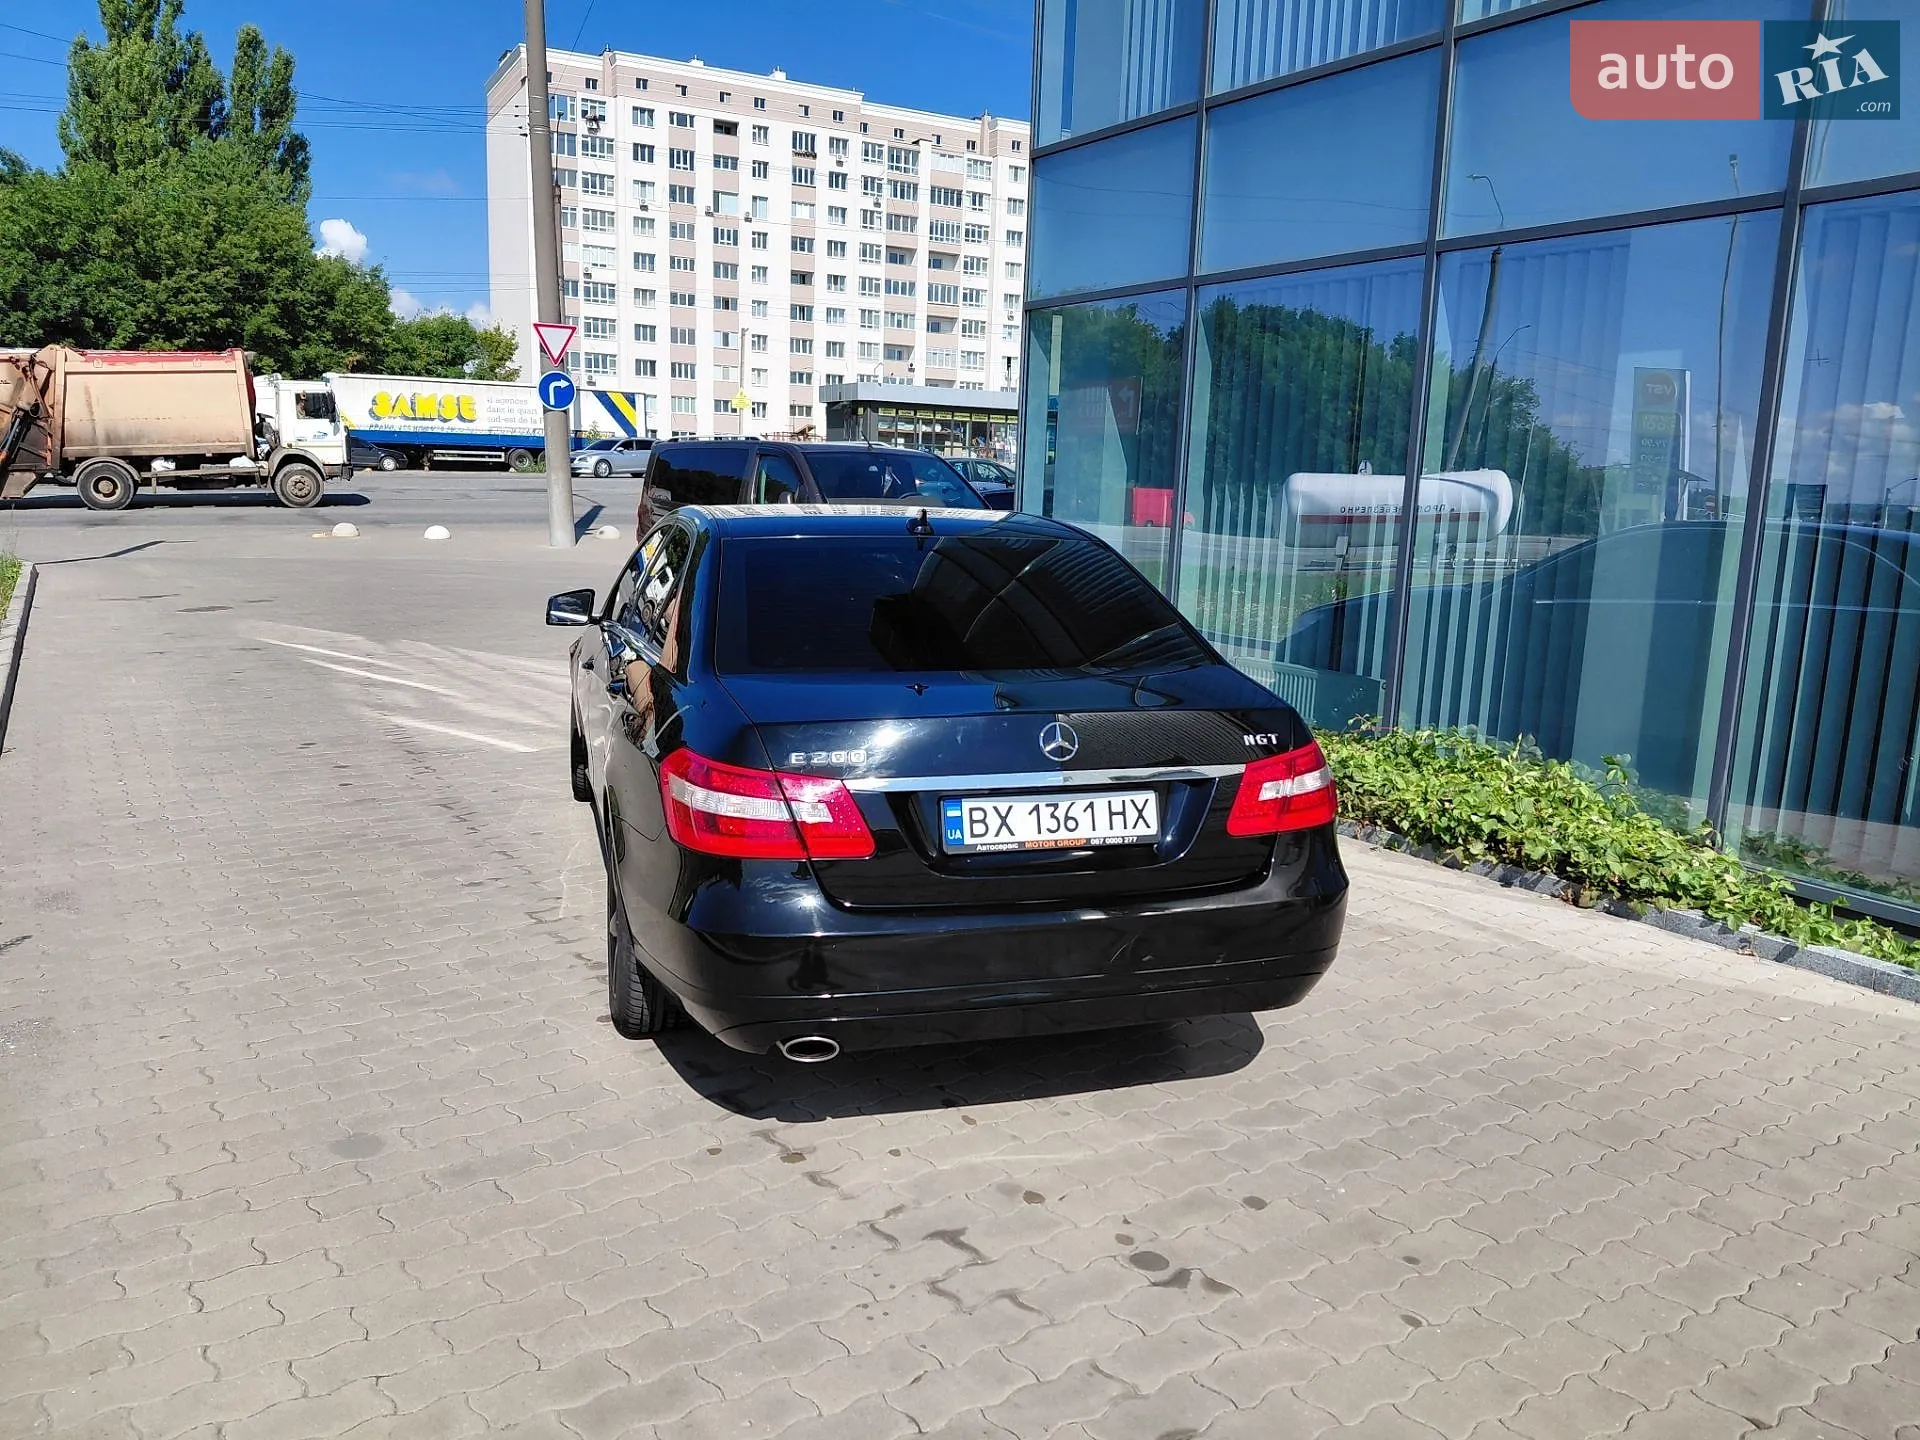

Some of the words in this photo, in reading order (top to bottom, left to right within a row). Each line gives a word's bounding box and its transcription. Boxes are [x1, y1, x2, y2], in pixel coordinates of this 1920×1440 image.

[369, 391, 477, 422] SAMSE
[487, 405, 506, 414] dans
[487, 414, 516, 423] sud-est
[518, 416, 529, 424] de
[1243, 733, 1279, 746] NGT
[790, 751, 806, 765] E
[811, 750, 867, 766] 200
[968, 804, 1016, 839] BX
[1028, 801, 1097, 835] 1361
[1107, 798, 1152, 831] HX
[947, 829, 963, 840] UA
[1024, 839, 1055, 848] MOTOR
[1056, 838, 1087, 847] GROUP
[1105, 836, 1123, 844] 0000
[1123, 835, 1138, 844] 277
